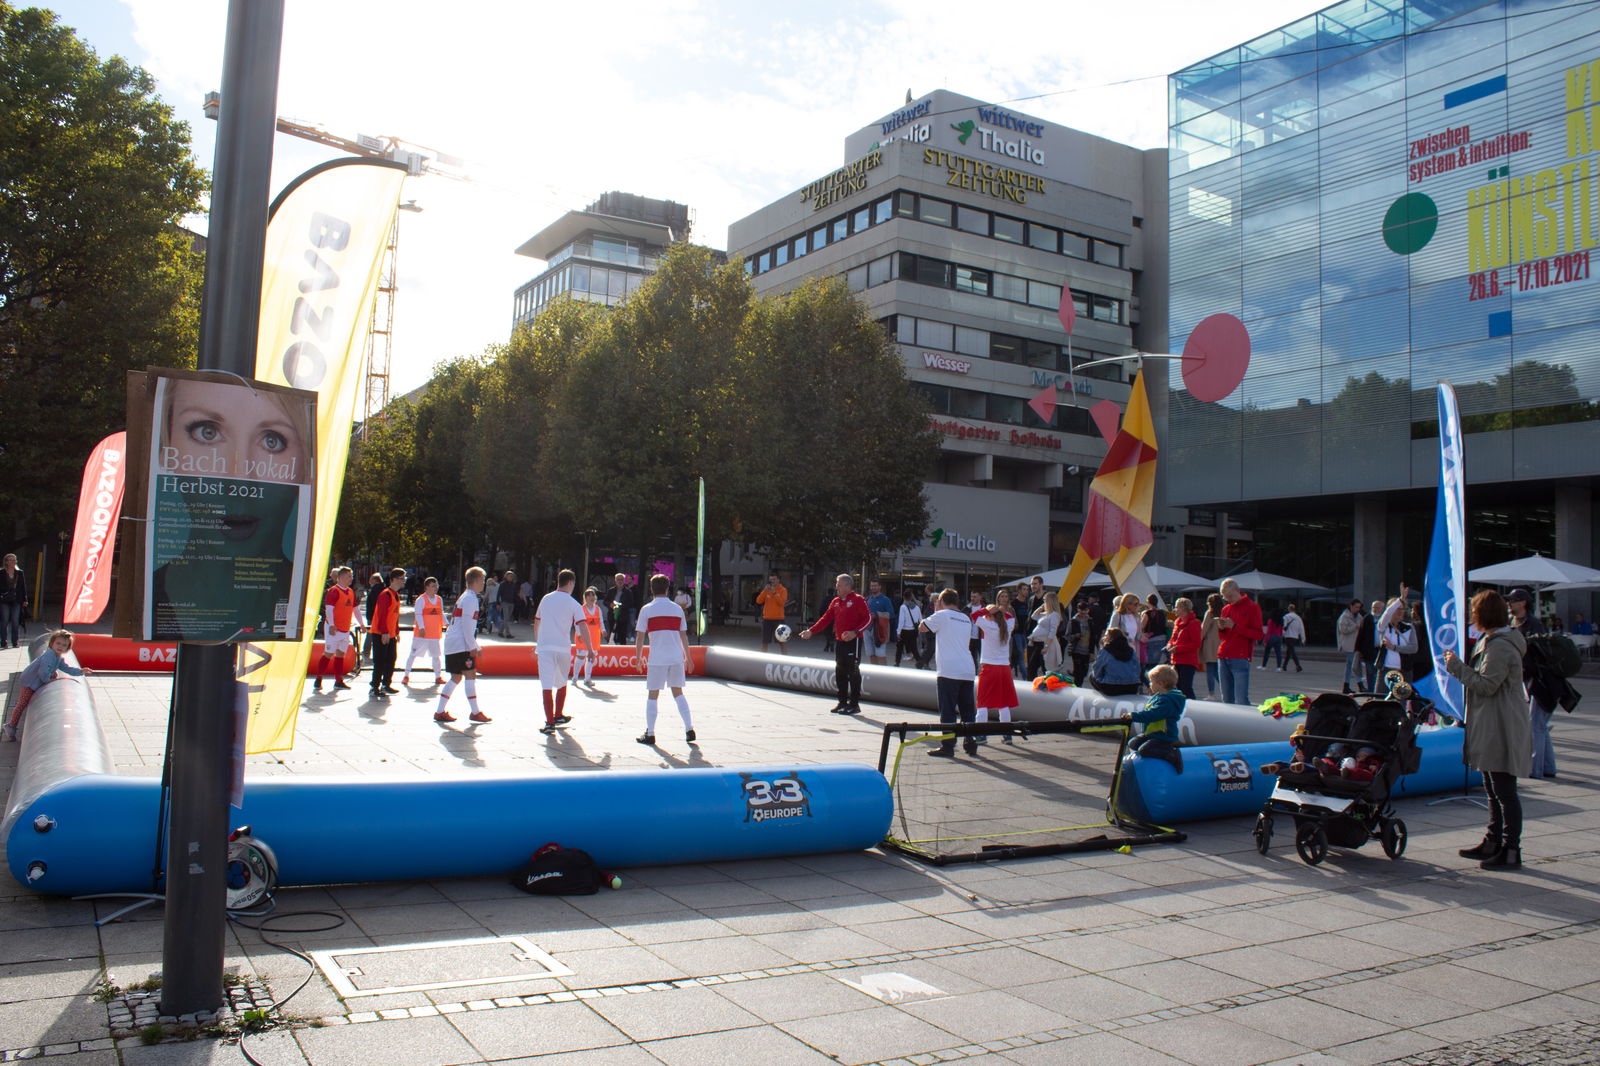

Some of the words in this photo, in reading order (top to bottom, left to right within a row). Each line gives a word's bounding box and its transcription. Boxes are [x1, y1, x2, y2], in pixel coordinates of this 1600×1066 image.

[977, 104, 1045, 138] wittwer
[977, 126, 1046, 166] Thalia
[800, 151, 882, 202] STUTTGARTER
[924, 148, 1046, 194] STUTTGARTER
[1409, 151, 1456, 183] system
[1458, 146, 1468, 167] &
[813, 173, 867, 211] ZEITUNG
[947, 170, 1028, 204] ZEITUNG
[1467, 157, 1600, 273] KÜNSTL
[922, 351, 971, 375] Wesser
[162, 446, 229, 474] Bach
[244, 454, 298, 481] vokal
[161, 476, 225, 496] Herbst
[228, 485, 265, 499] 2021
[77, 448, 121, 610] BAZOOKAGOAL
[945, 532, 997, 552] Thalia
[139, 647, 178, 662] BAZ
[745, 779, 804, 805] 3v3
[1226, 782, 1250, 791] EUROPE
[764, 807, 804, 819] EUROPE
